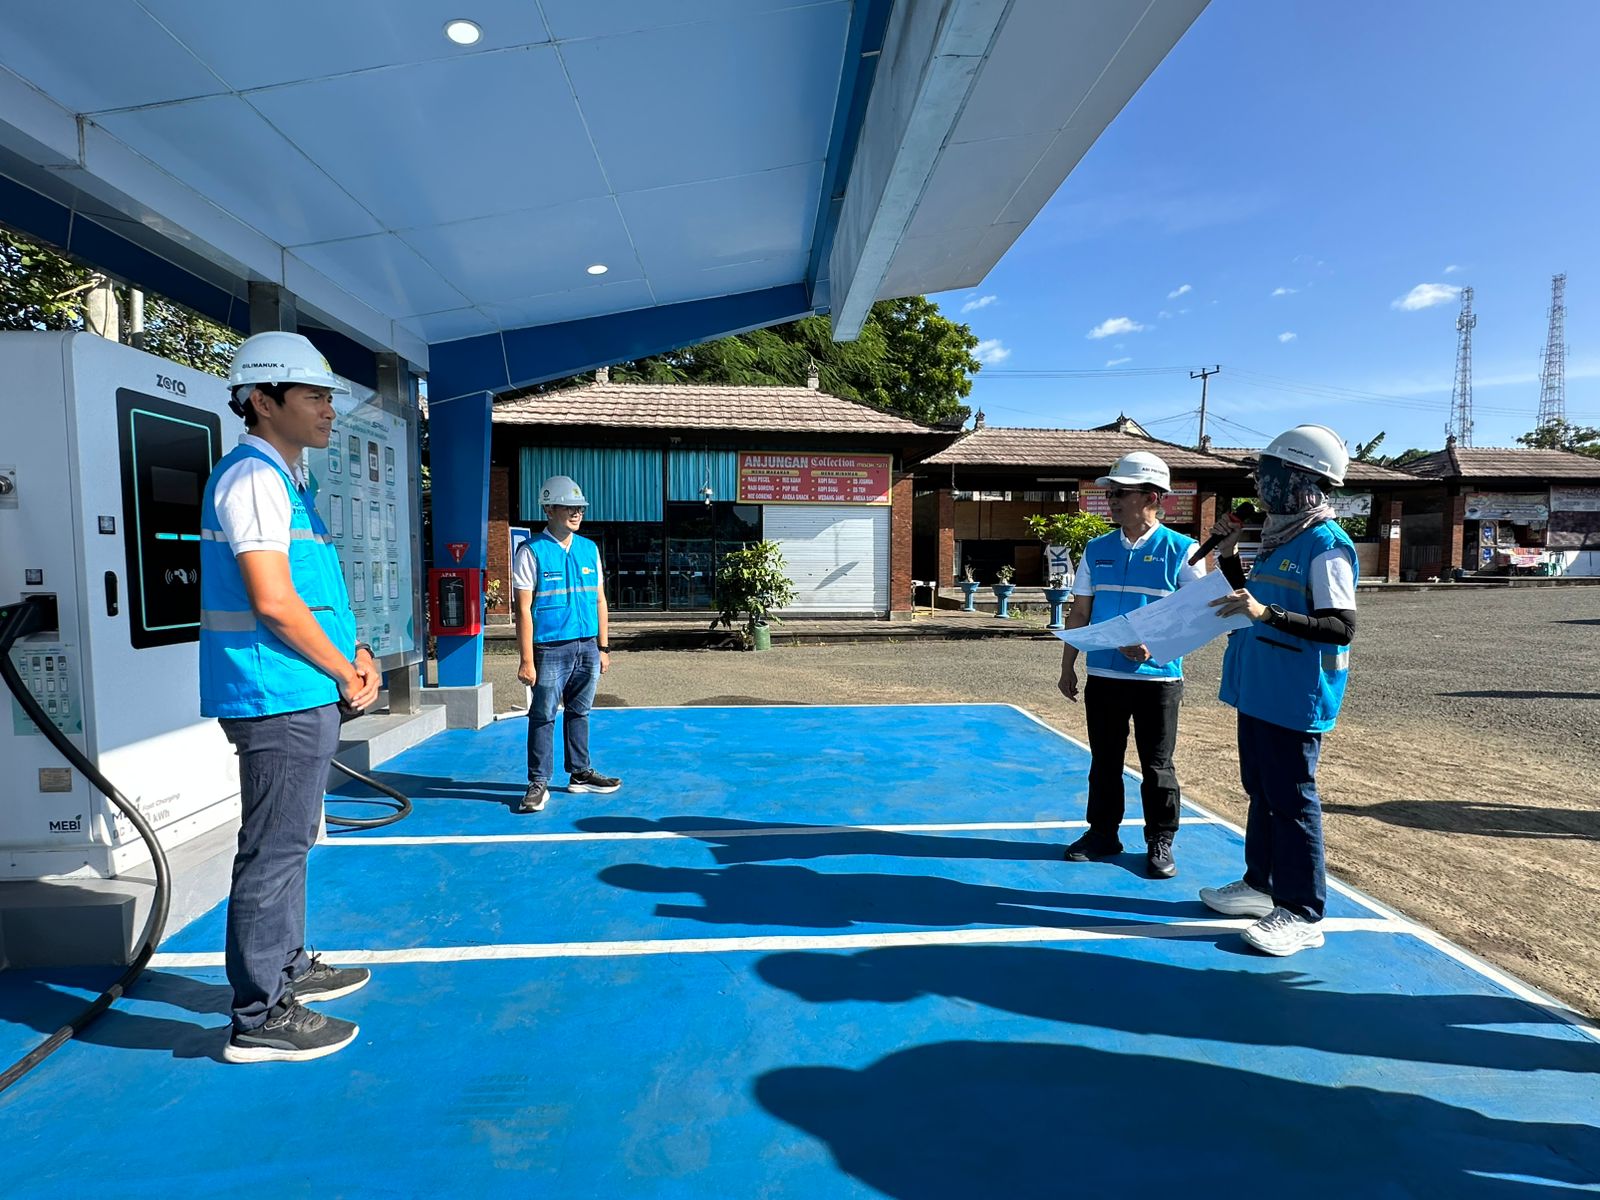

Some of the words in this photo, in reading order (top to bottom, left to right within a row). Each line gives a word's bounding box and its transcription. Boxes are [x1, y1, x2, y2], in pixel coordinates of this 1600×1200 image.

[744, 456, 809, 468] ANJUNGAN
[811, 457, 855, 468] Collection
[49, 820, 81, 831] MEBI
